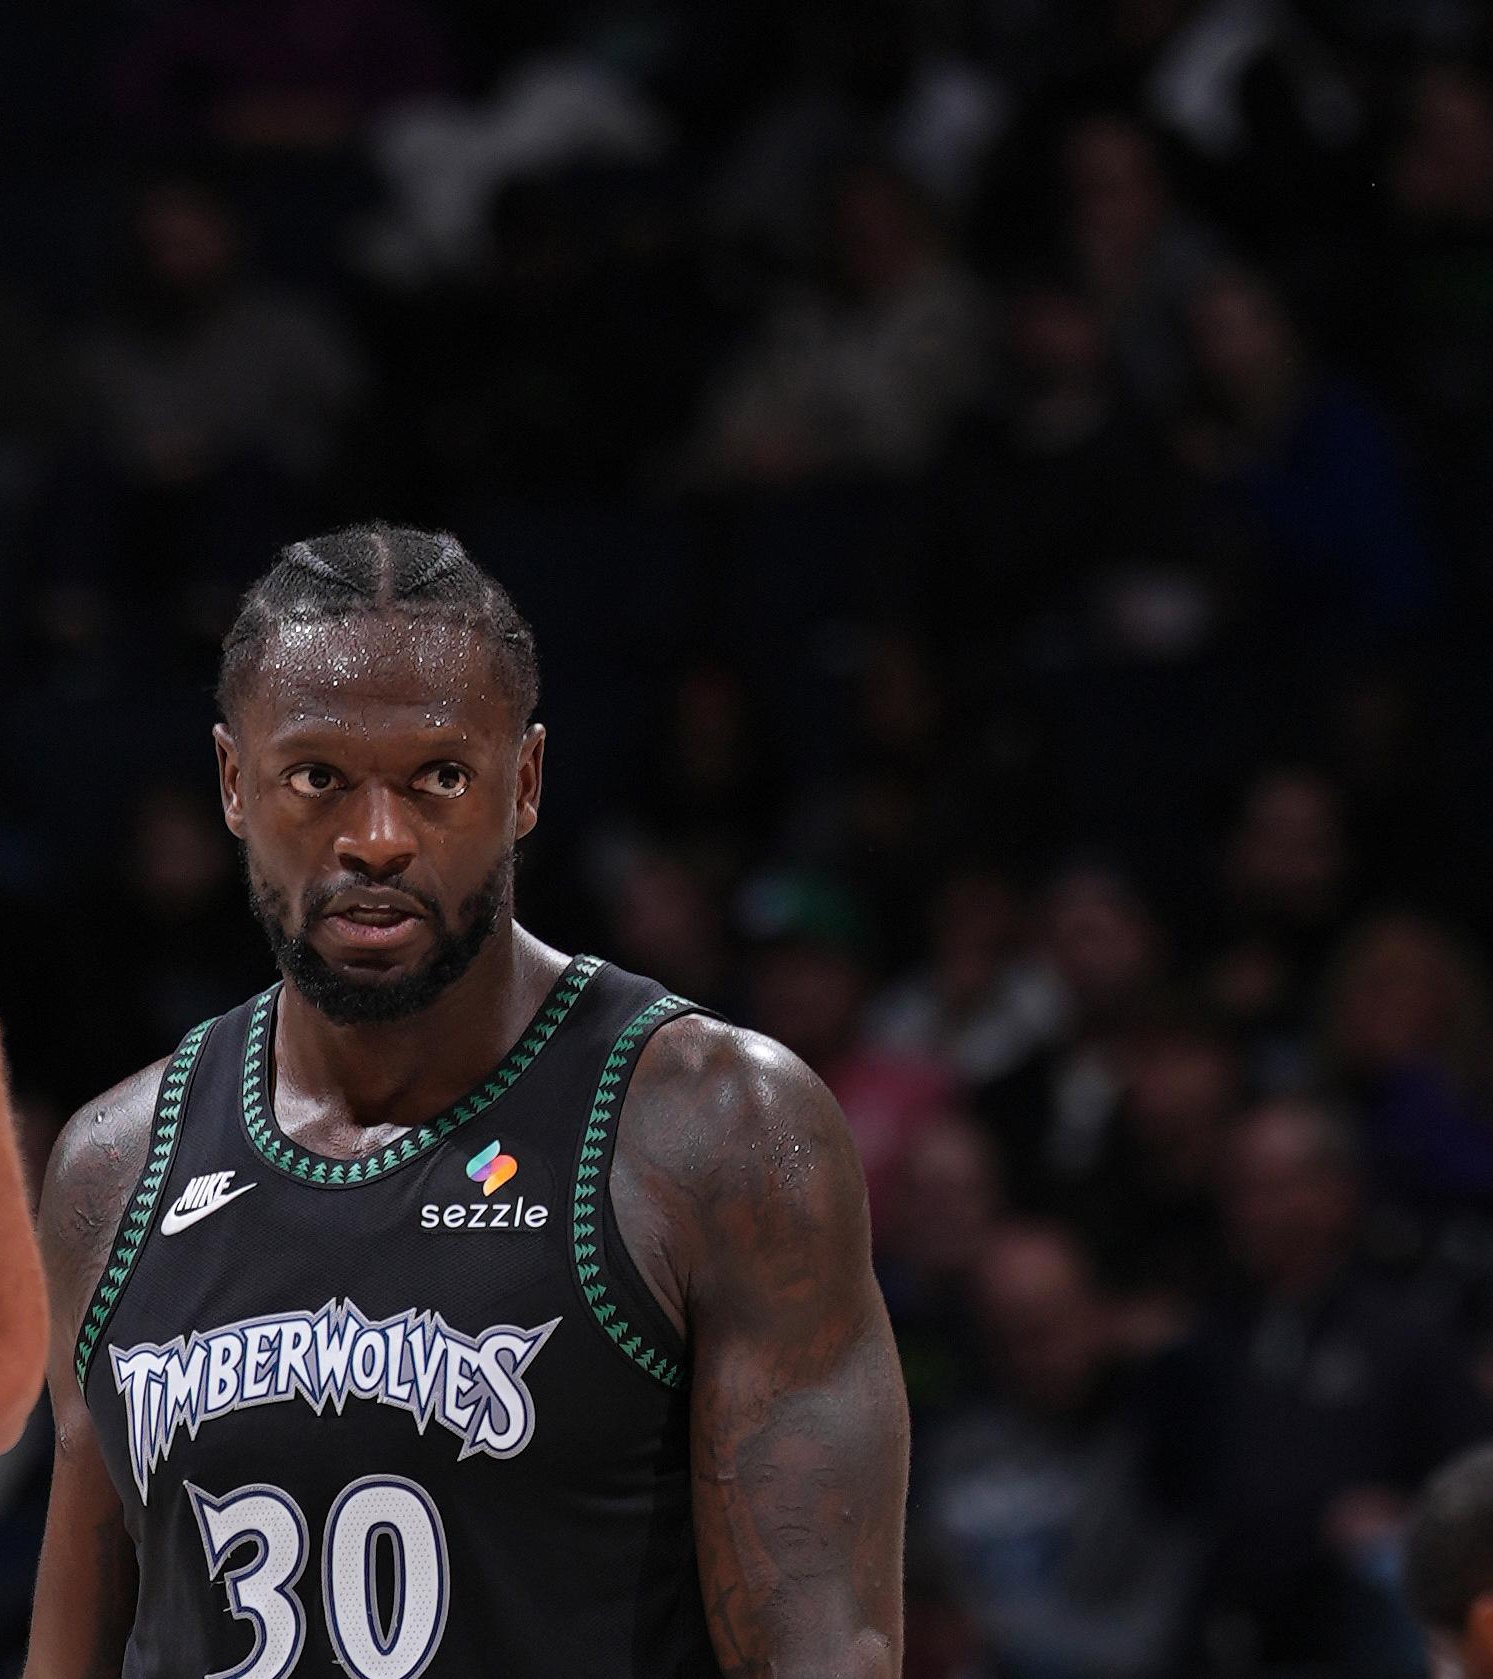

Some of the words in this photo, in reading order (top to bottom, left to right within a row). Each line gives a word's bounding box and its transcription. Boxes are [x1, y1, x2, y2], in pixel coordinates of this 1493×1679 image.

[176, 1170, 236, 1212] NIKE
[420, 1196, 550, 1230] sezzle
[109, 1297, 563, 1506] TIMBERWOLVES
[182, 1473, 451, 1679] 30
